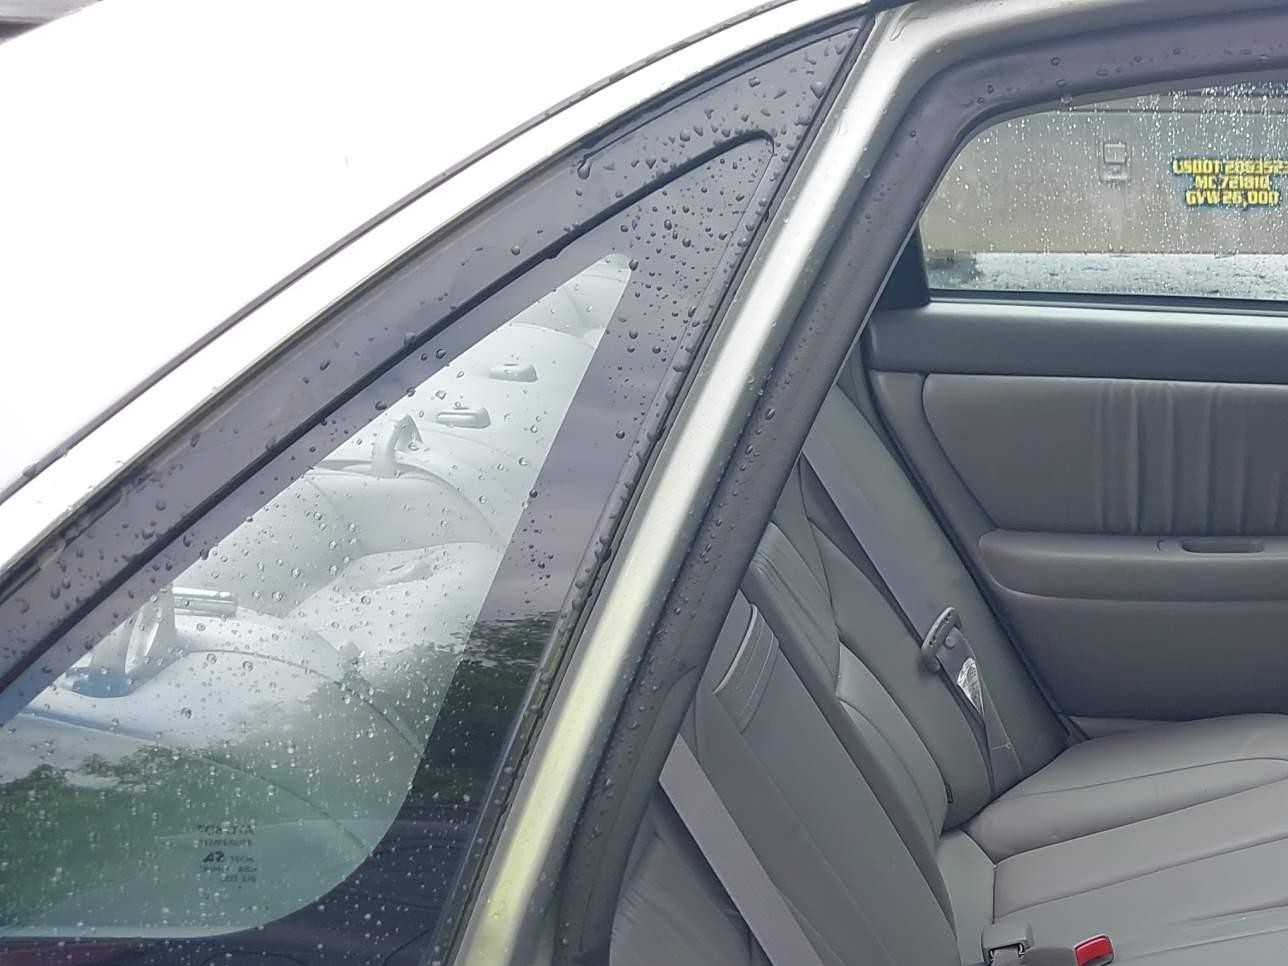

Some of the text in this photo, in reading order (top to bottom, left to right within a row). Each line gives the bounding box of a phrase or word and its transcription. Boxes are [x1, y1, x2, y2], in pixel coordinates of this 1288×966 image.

[1172, 158, 1220, 174] USDOT
[1195, 175, 1217, 189] MC
[1185, 190, 1280, 208] GVW 26,000
